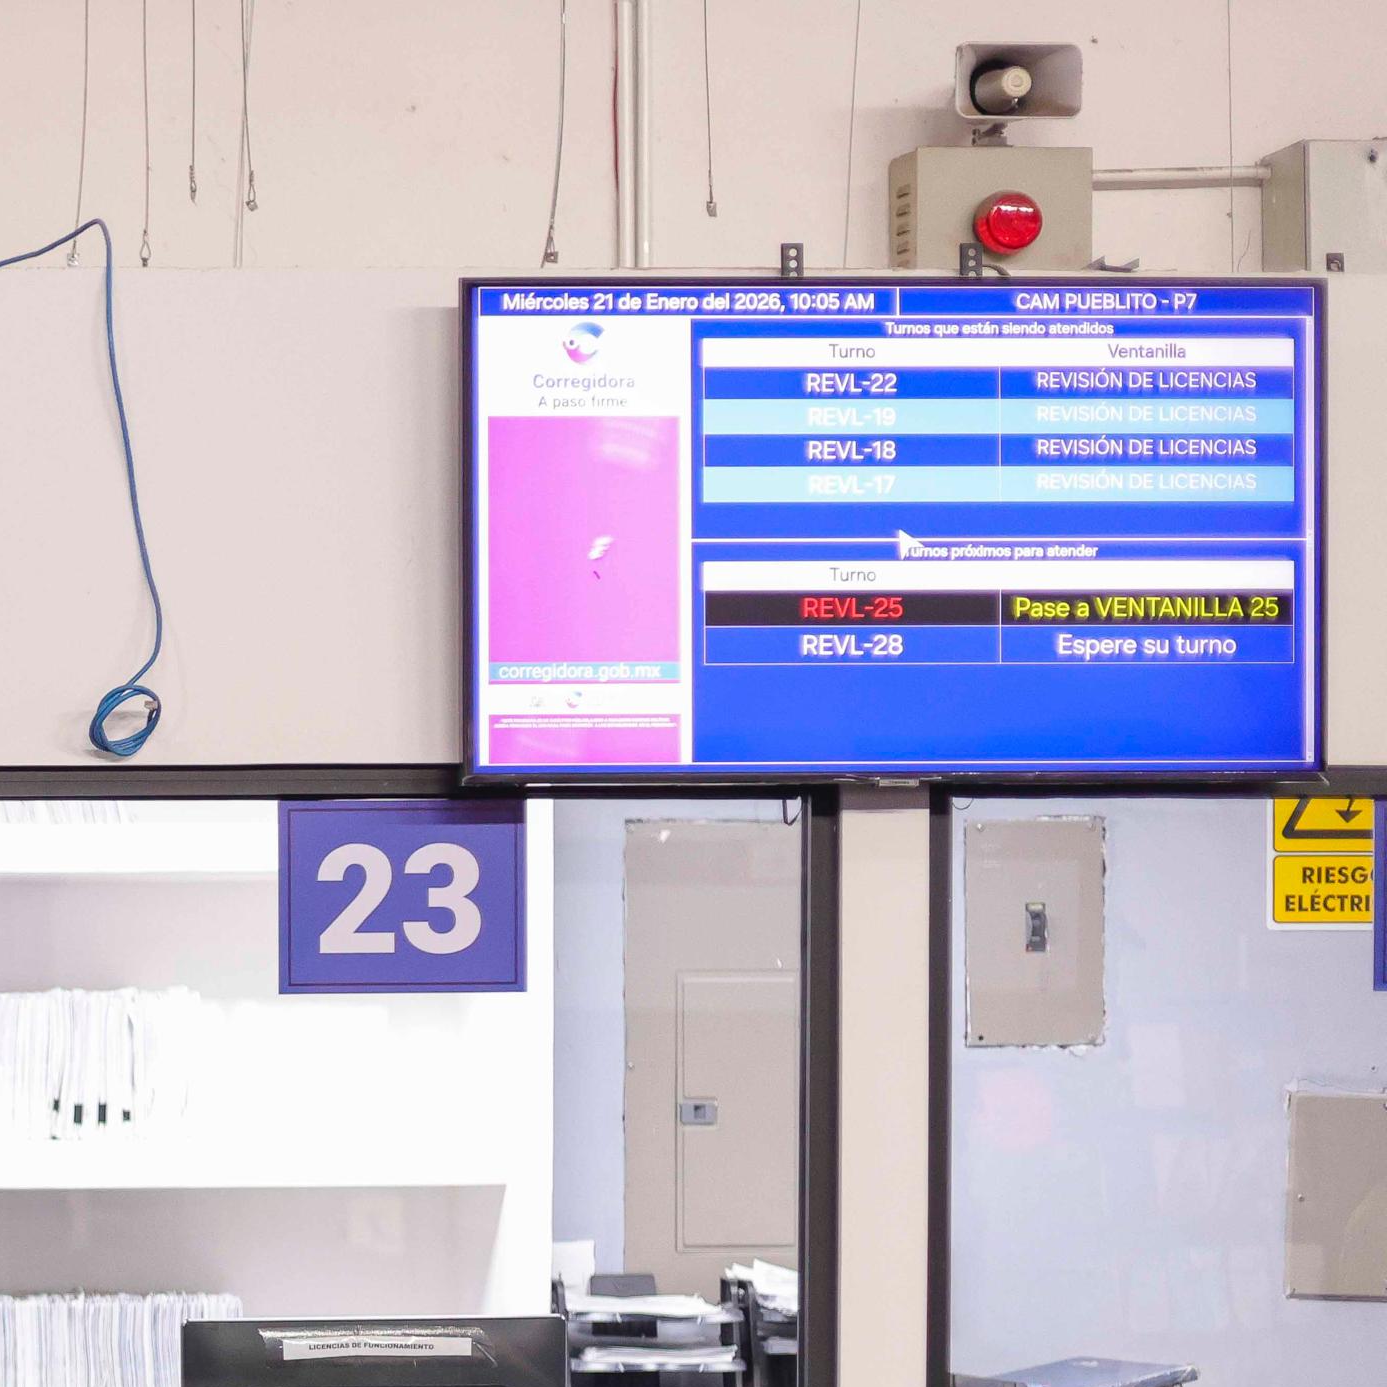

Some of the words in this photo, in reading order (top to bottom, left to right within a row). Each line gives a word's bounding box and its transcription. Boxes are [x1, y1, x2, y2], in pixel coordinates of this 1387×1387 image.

[502, 292, 589, 311] Miércoles
[593, 293, 614, 310] 21
[618, 292, 642, 310] de
[646, 293, 699, 310] Enero
[702, 292, 730, 310] del
[734, 293, 786, 312] 2026,
[790, 293, 840, 310] 10:05
[844, 293, 875, 310] AM
[1015, 293, 1060, 310] CAM
[1065, 293, 1157, 310] PUEBLITO
[1174, 292, 1198, 310] P7
[884, 321, 931, 335] Turnos
[933, 325, 960, 338] que
[962, 321, 999, 335] están
[1002, 321, 1046, 335] siendo
[1048, 321, 1115, 335] atendidos
[829, 343, 876, 359] Turno
[1108, 343, 1187, 359] Ventanilla
[532, 374, 635, 391] Corregidora
[806, 372, 898, 393] REVL-22
[1037, 368, 1123, 388] REVISIÓN
[1129, 372, 1154, 388] DE
[1159, 371, 1257, 388] LICENCIAS
[538, 396, 547, 407] A
[553, 398, 586, 410] paso
[1037, 402, 1123, 422] REVISIÓN
[1129, 406, 1154, 422] DE
[1159, 406, 1257, 422] LICENCIAS
[807, 407, 897, 427] REVL-19
[807, 440, 897, 460] REVL-18
[1037, 435, 1123, 455] REVISIÓN
[1129, 439, 1154, 455] DE
[1159, 439, 1257, 455] LICENCIAS
[807, 474, 896, 495] REVL-17
[1037, 469, 1123, 489] REVISIÓN
[1129, 473, 1154, 489] DE
[1159, 473, 1257, 489] LICENCIAS
[951, 544, 1011, 560] próximos
[1015, 547, 1044, 560] para
[1047, 544, 1099, 558] atender
[829, 567, 877, 583] Turno
[802, 597, 904, 618] REVL-25
[1015, 596, 1070, 617] Pase
[1077, 602, 1090, 617] a
[1096, 596, 1244, 617] VENTANILLA
[1250, 596, 1279, 617] 25
[802, 635, 904, 656] REVL-28
[1058, 633, 1137, 661] Espere
[1143, 639, 1169, 654] su
[1176, 635, 1237, 655] turno
[498, 662, 661, 683] corregidora.gob.mx
[1301, 866, 1373, 884] RIESG
[317, 842, 482, 955] 23
[1284, 889, 1371, 912] ELÉCTRI
[308, 1342, 349, 1351] LICENCIAS
[363, 1342, 435, 1351] FUNCIONAMIENTO
